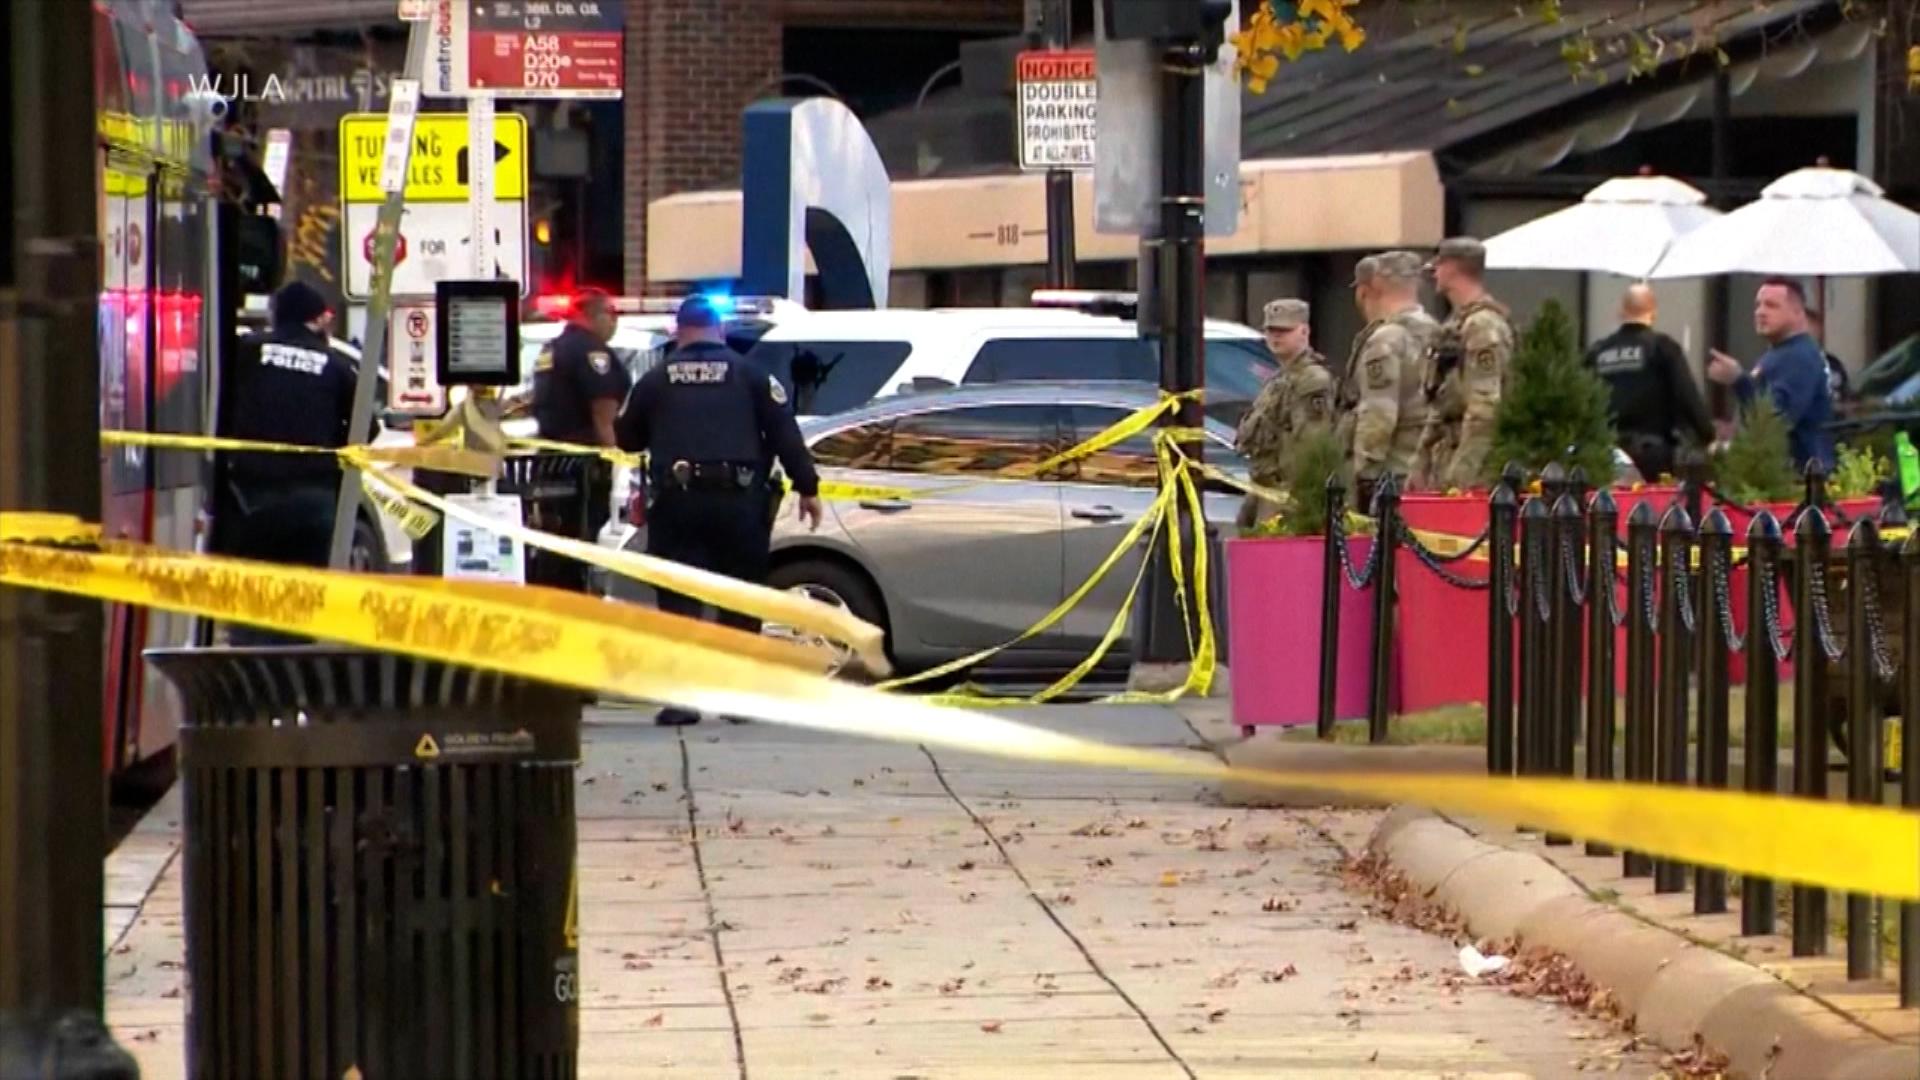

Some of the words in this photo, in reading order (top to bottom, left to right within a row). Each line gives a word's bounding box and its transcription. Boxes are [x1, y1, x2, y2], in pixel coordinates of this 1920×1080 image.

[525, 35, 559, 50] A58
[1025, 61, 1095, 78] NOTICE
[525, 72, 559, 87] D70
[1026, 84, 1096, 100] DOUBLE
[1026, 104, 1097, 119] PARKING
[1026, 124, 1097, 140] PROHIBITED
[355, 131, 442, 158] TUNG
[359, 165, 443, 185] VELES
[998, 224, 1018, 245] 818
[420, 240, 445, 253] FOR
[261, 352, 323, 375] POLICE
[669, 371, 726, 384] POLICE
